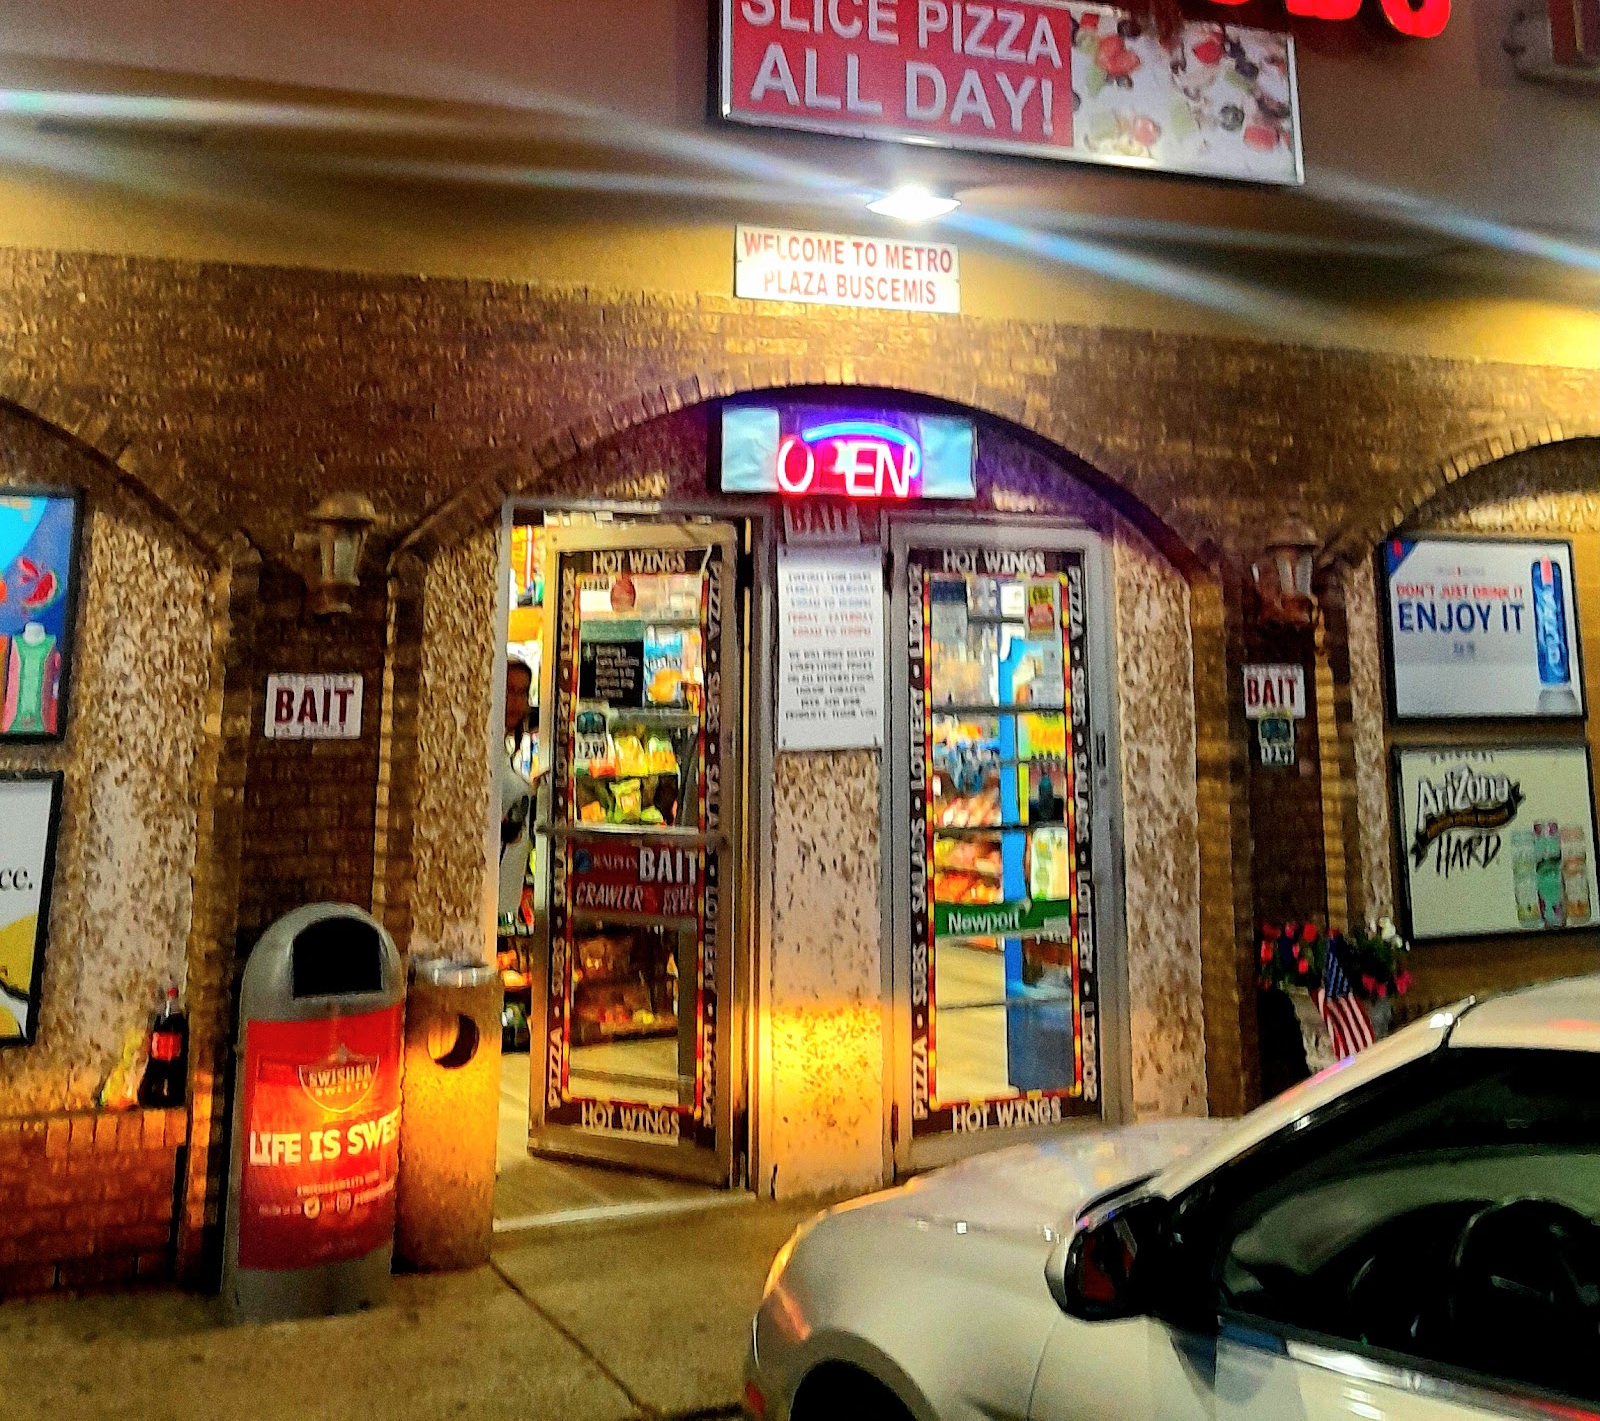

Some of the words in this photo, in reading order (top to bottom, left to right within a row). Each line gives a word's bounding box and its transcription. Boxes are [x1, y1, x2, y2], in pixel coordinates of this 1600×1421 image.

[750, 42, 883, 115] ALL
[906, 61, 1055, 138] DAY!
[743, 231, 845, 266] WELCOME
[852, 241, 878, 268] TO
[885, 243, 954, 274] METRO
[764, 269, 829, 297] PLAZA
[836, 274, 937, 305] BUSCEMIS
[777, 436, 914, 497] OPEN
[593, 551, 624, 574] HOT
[630, 550, 686, 574] WINGS
[943, 550, 977, 574] HOT
[984, 550, 1047, 574] WINGS
[708, 560, 723, 642] PIZZA
[1068, 565, 1083, 641] PIZZA
[1396, 583, 1435, 599] DON'T
[1398, 602, 1492, 634] ENJOY
[1501, 602, 1524, 634] IT
[275, 688, 354, 725] BAIT
[1247, 677, 1297, 708] BAIT
[909, 686, 925, 791] LOTTERY
[640, 846, 697, 885] BAIT
[910, 817, 926, 914] SALADS
[1436, 833, 1502, 879] HARD
[948, 910, 1020, 936] Newport
[911, 941, 927, 1006] SUBS
[547, 1025, 563, 1109] PIZZA
[912, 1034, 928, 1121] PIZZA
[581, 1101, 614, 1130] HOT
[620, 1105, 681, 1137] WINGS
[951, 1103, 989, 1133] HOT
[995, 1097, 1062, 1128] WINGS
[249, 1130, 302, 1167] LIFE
[308, 1129, 341, 1162] IS
